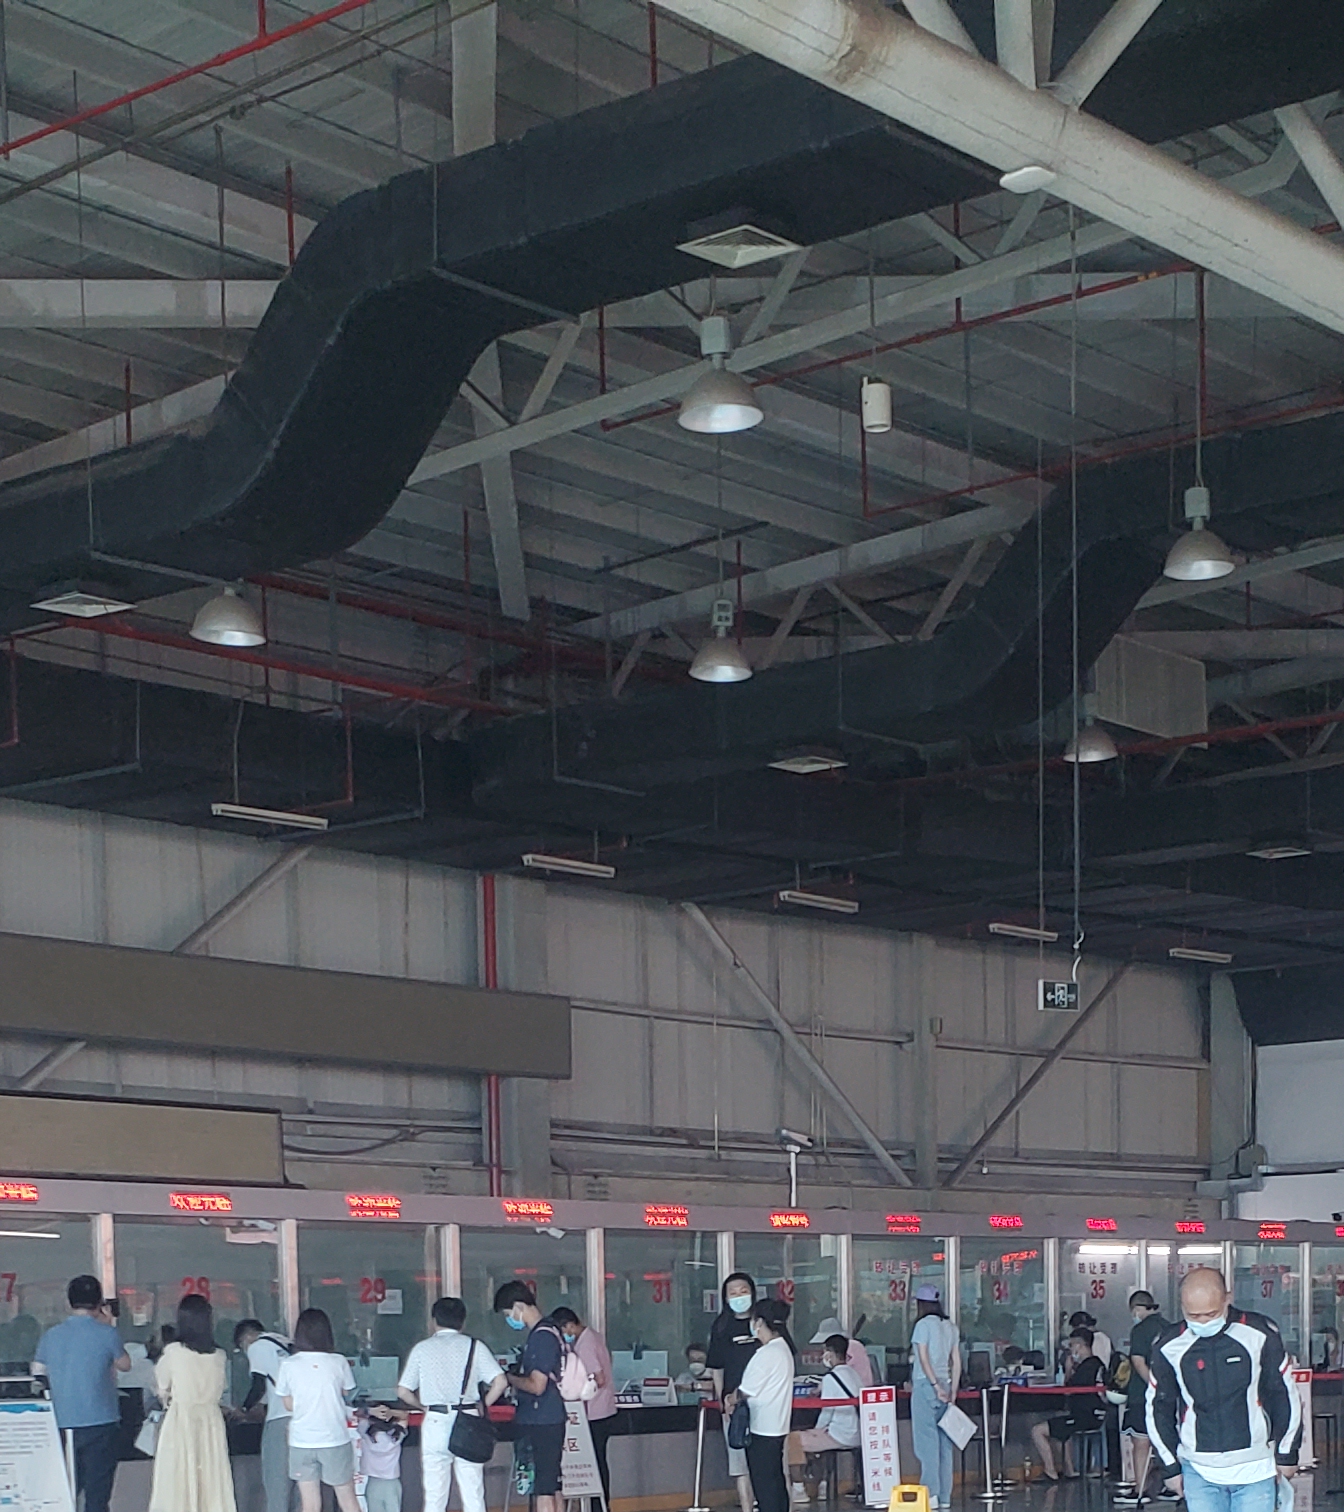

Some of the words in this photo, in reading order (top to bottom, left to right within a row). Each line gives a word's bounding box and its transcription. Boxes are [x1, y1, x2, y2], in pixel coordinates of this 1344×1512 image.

[360, 1277, 387, 1304] 29
[652, 1280, 671, 1303] 31
[889, 1280, 906, 1300] 33
[1090, 1280, 1105, 1299] 35
[1261, 1280, 1274, 1299] 37
